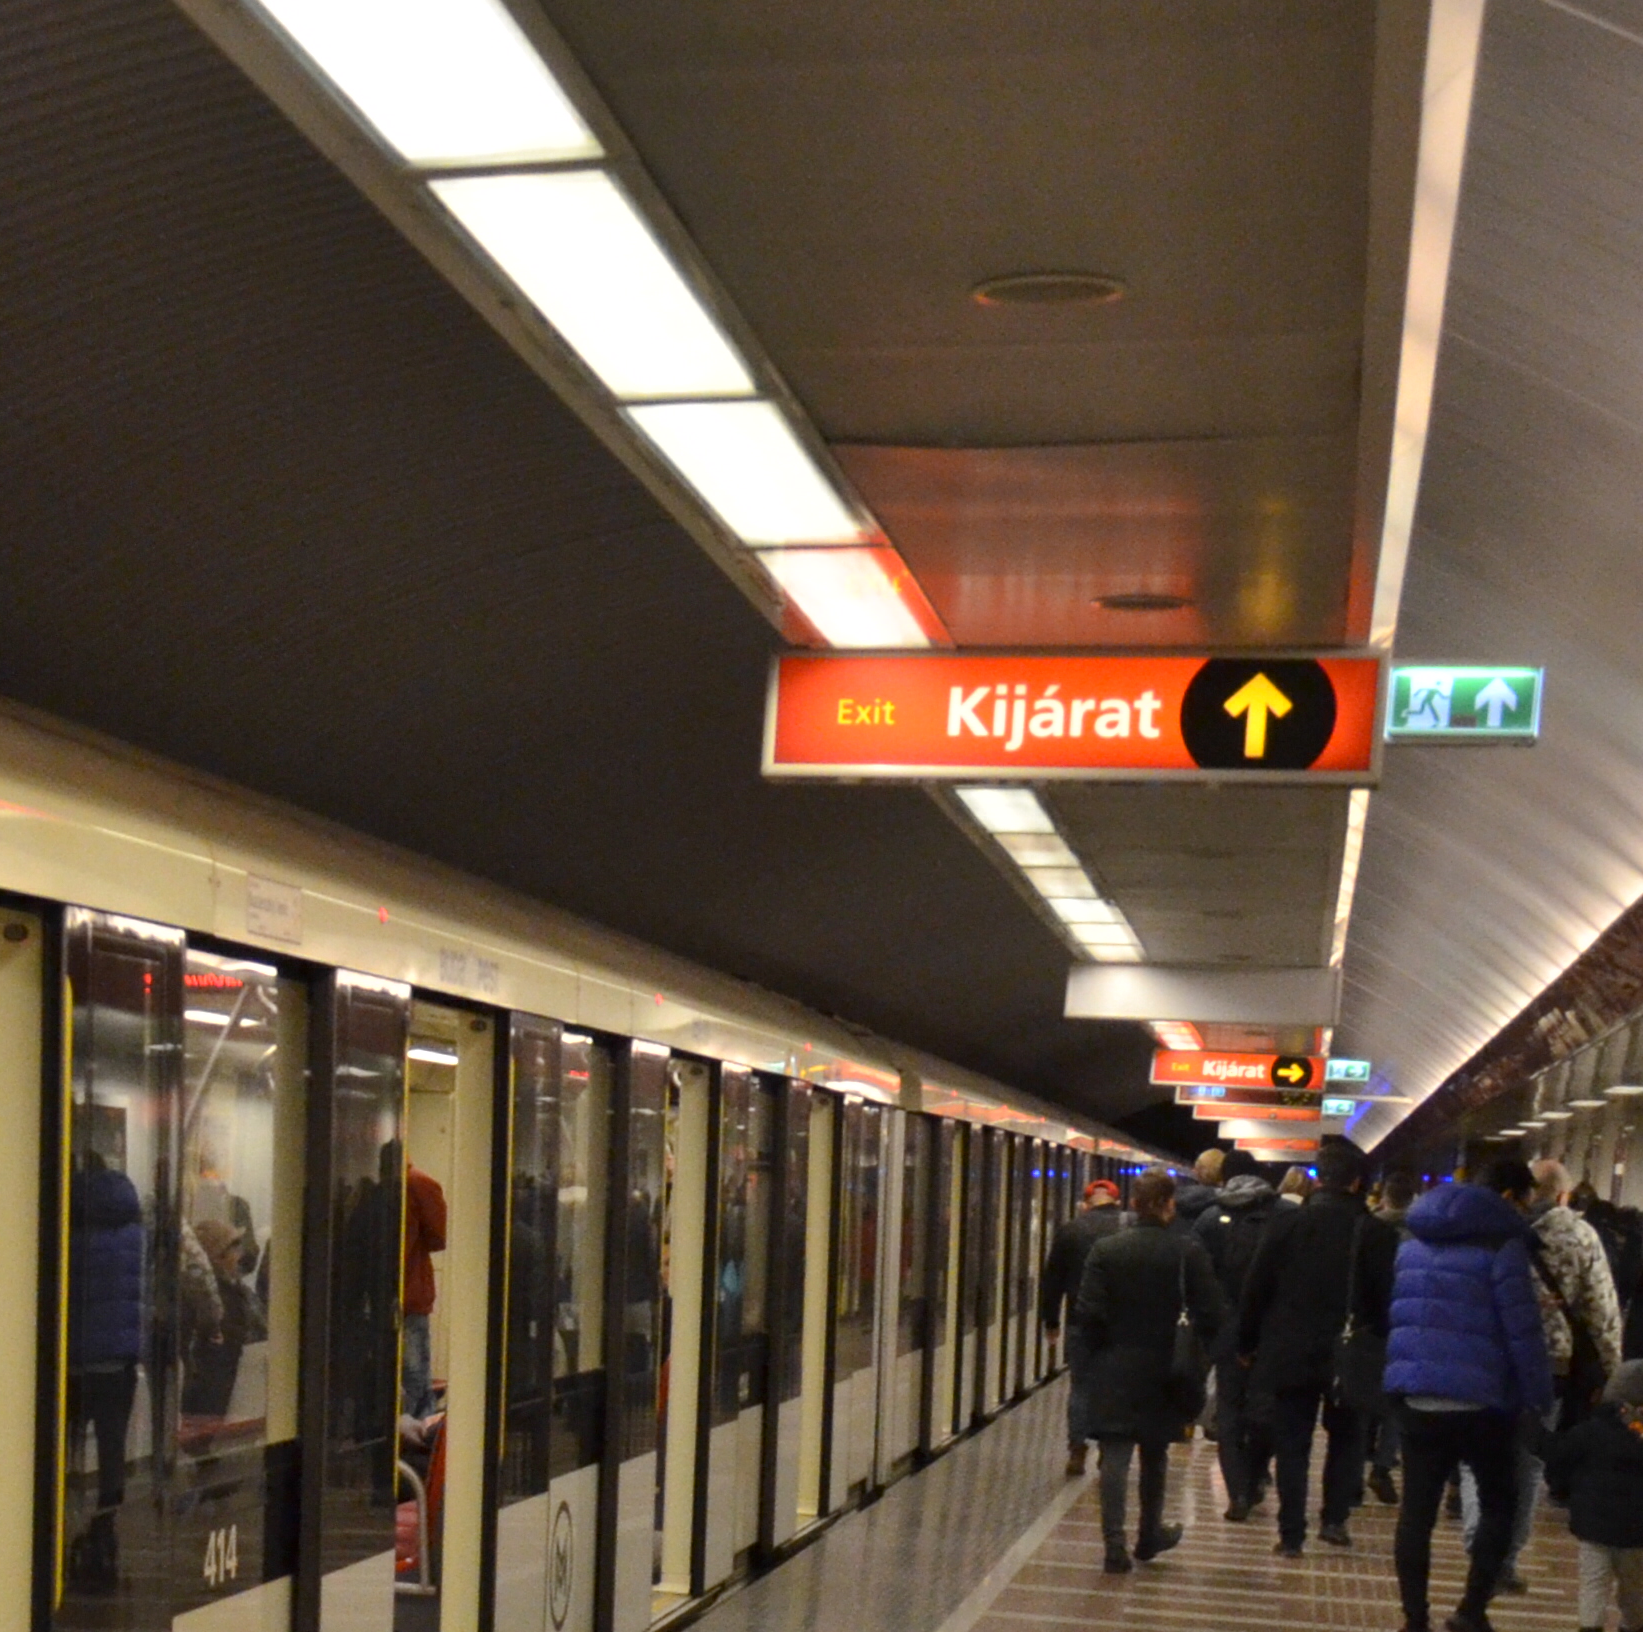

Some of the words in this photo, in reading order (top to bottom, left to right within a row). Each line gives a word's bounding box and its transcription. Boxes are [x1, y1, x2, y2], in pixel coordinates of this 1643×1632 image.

[837, 698, 895, 726] Exit
[946, 683, 1162, 752] Kijárat
[1202, 1060, 1265, 1080] Kijárat
[202, 1523, 239, 1587] 414
